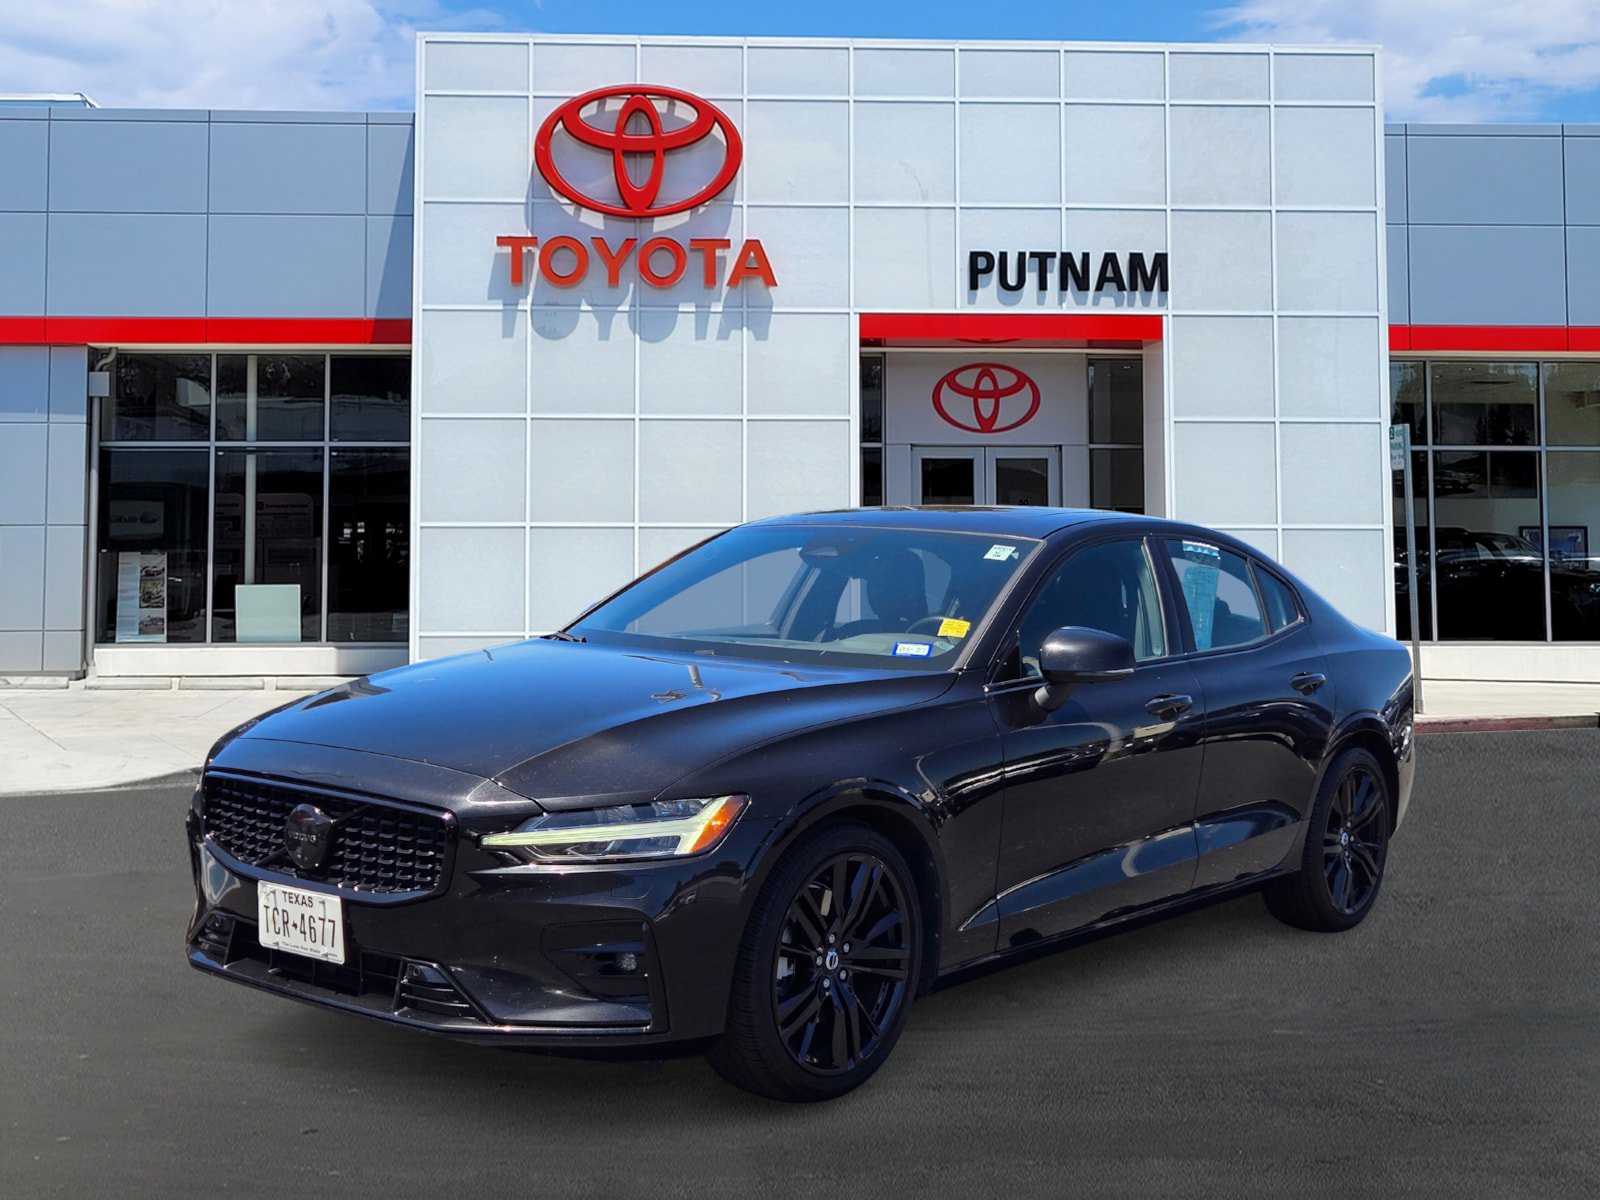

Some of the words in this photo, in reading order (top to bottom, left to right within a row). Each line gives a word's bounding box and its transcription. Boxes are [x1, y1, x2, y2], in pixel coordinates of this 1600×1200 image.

[496, 236, 778, 287] TOYOTA
[969, 251, 1169, 292] PUTNAM
[282, 891, 314, 908] TEXAS
